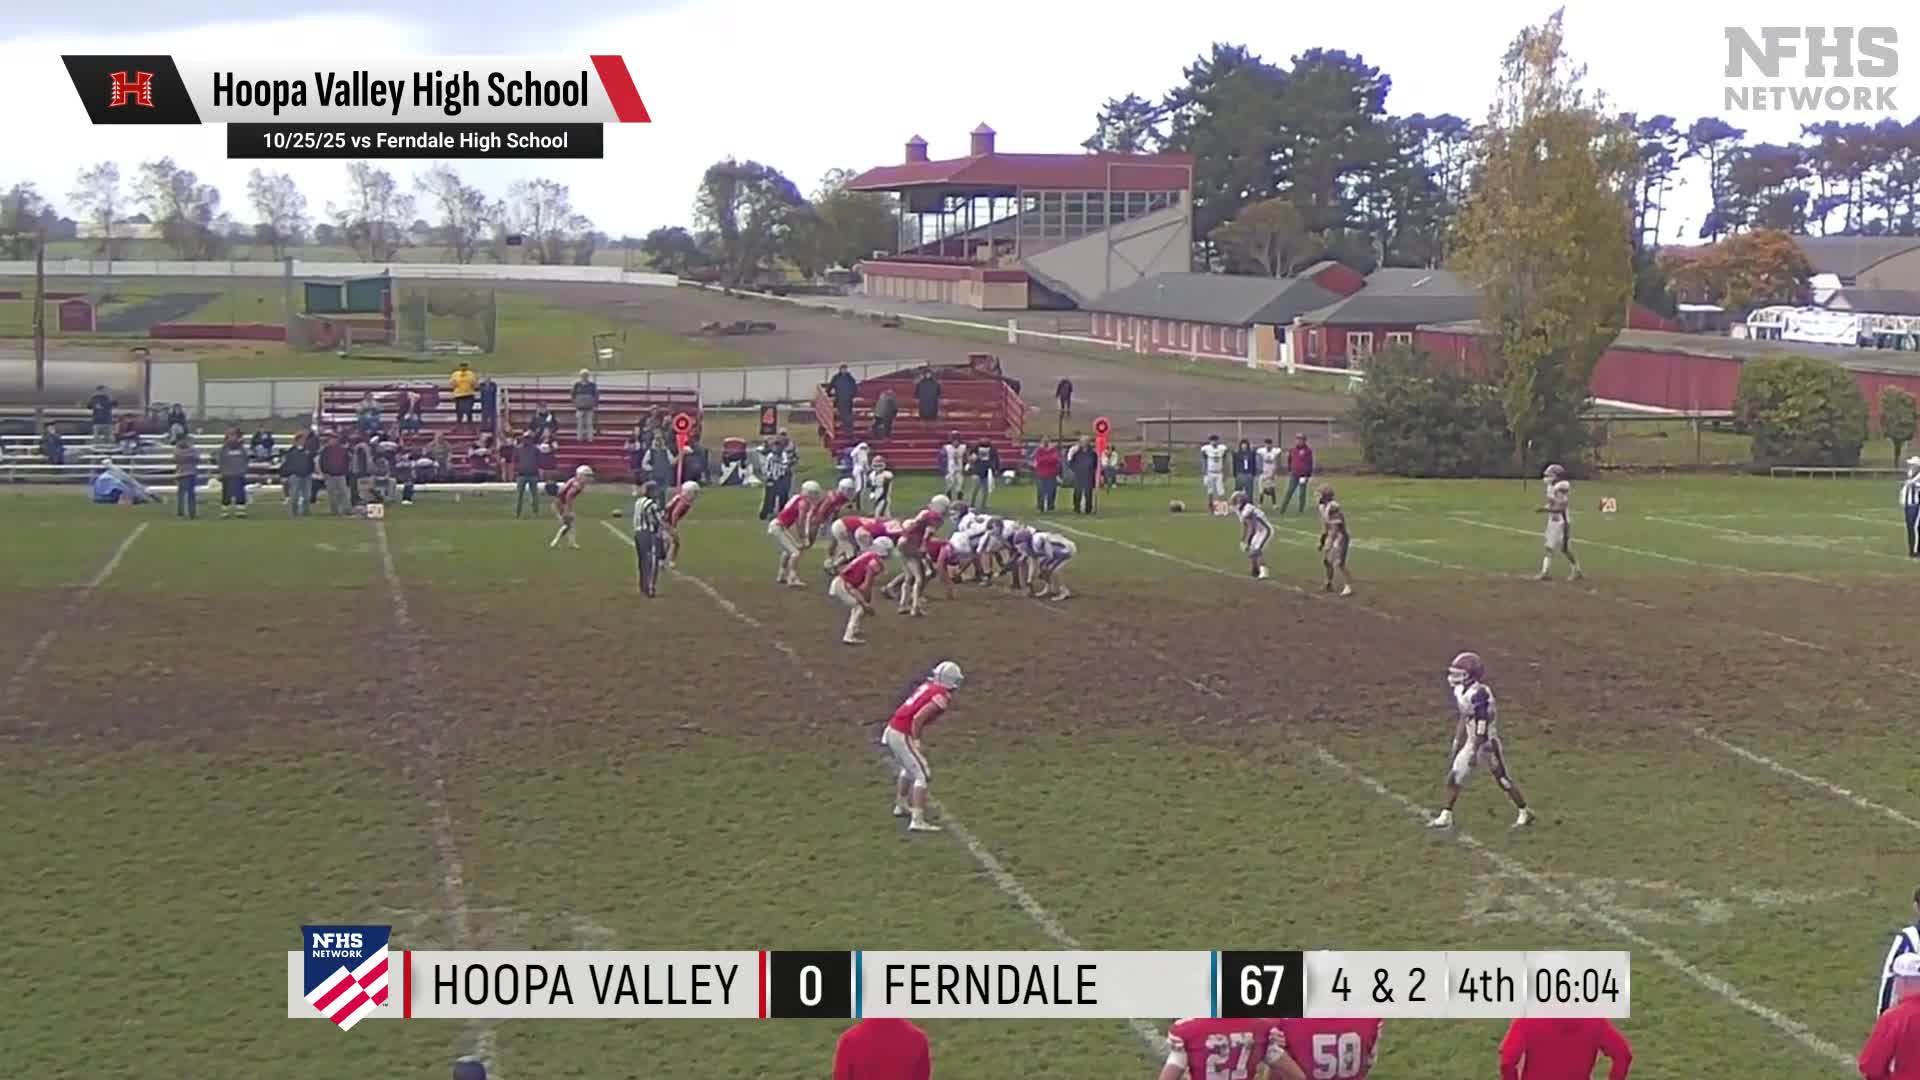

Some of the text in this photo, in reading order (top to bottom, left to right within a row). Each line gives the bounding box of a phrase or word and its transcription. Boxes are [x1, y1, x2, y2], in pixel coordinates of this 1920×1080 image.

[762, 407, 775, 425] 4
[367, 503, 384, 518] 50
[1213, 500, 1229, 516] 30
[1205, 1032, 1254, 1080] 27
